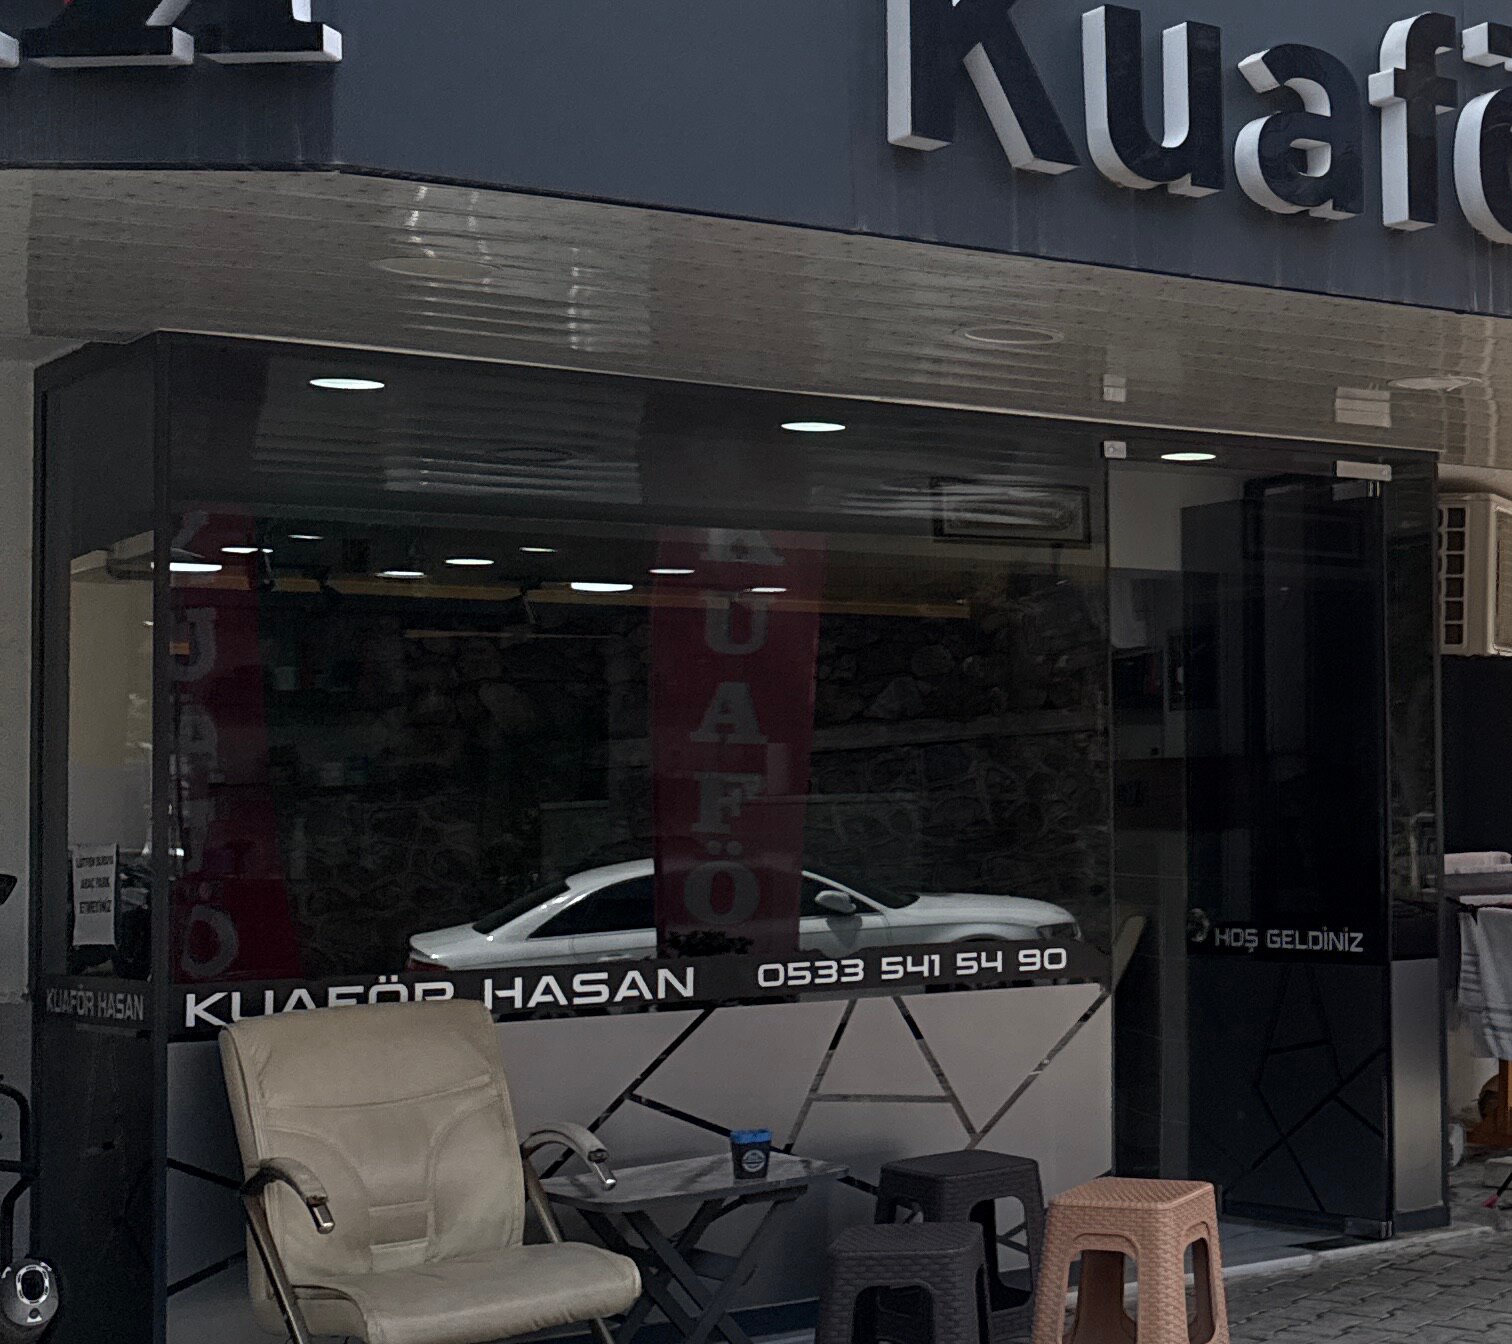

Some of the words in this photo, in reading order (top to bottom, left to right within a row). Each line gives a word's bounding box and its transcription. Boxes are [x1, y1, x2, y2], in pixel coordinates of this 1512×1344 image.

[1214, 927, 1259, 953] HOŞ
[1266, 925, 1364, 953] GELDİNİZ
[757, 958, 865, 988] 0533
[880, 954, 941, 980] 541
[956, 950, 1003, 975] 54
[1017, 947, 1067, 972] 90
[46, 983, 95, 1017] KUAFÖR
[97, 991, 144, 1021] HASAN
[483, 965, 695, 1010] HASAN
